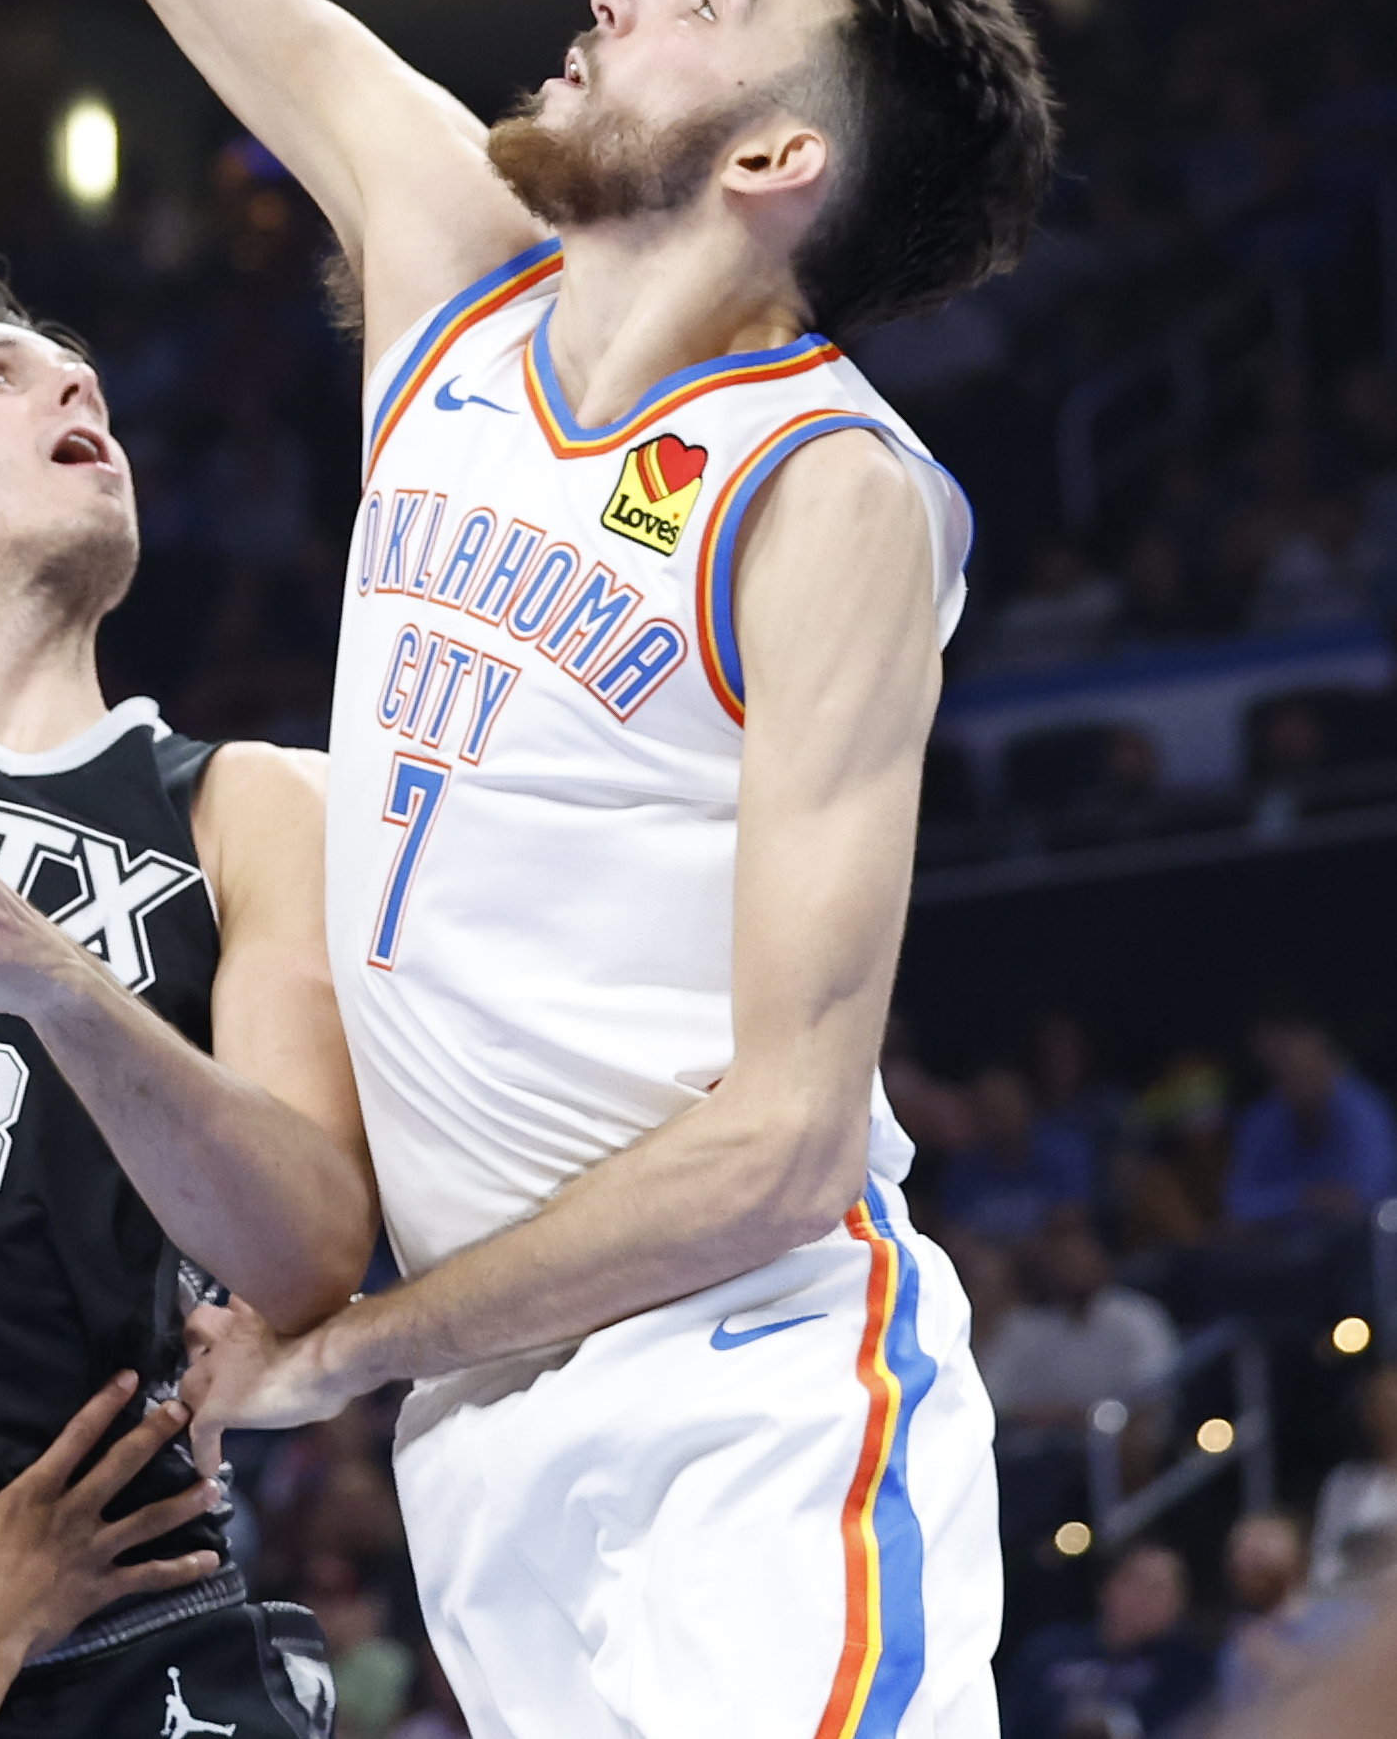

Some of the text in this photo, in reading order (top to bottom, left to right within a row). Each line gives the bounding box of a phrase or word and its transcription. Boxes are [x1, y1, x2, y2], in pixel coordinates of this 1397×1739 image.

[357, 487, 687, 724] OKLAHOMA
[376, 623, 522, 767] CITY
[366, 751, 452, 972] 7
